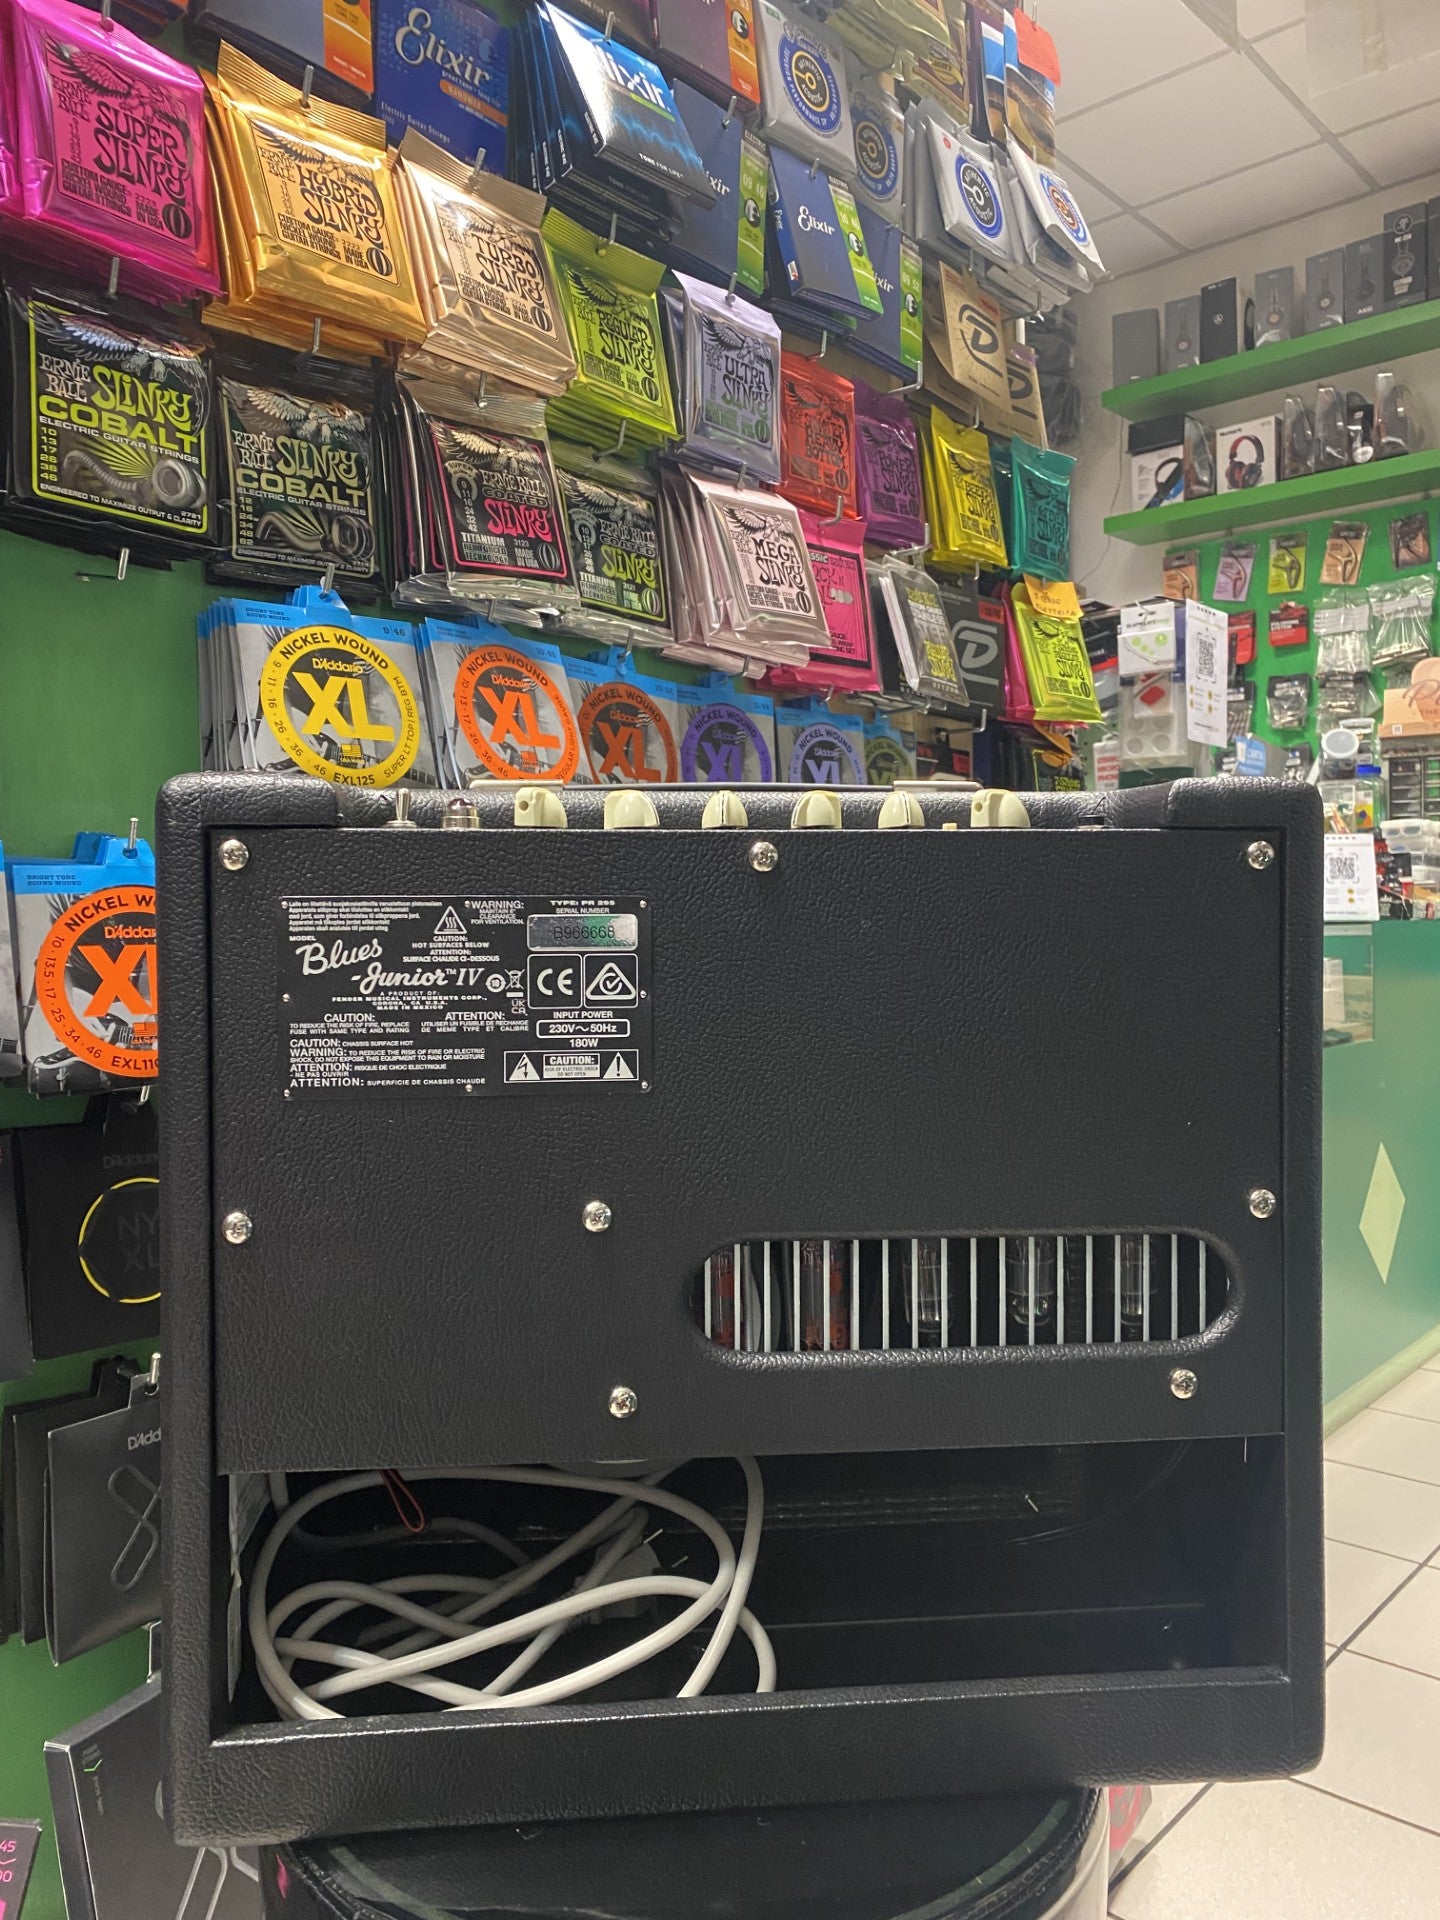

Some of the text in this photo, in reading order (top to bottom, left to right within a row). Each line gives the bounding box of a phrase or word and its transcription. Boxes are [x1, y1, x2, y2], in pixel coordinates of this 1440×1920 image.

[395, 7, 491, 87] Elixir
[381, 101, 450, 143] Electric Guitar Strings
[96, 101, 187, 169] SUPER
[744, 130, 767, 151] ELECTRIC
[278, 213, 335, 240] CUSTOM GAUGE
[798, 205, 835, 236] Elixir
[280, 222, 336, 248] NICKEL WOUND
[282, 230, 342, 260] GUITAR STRINGS
[343, 246, 364, 260] MADE
[472, 233, 536, 280] TURBO
[596, 308, 653, 350] REGULAR
[724, 354, 768, 393] ULTRA
[46, 373, 88, 403] BALL
[39, 395, 198, 455] COBALT
[41, 427, 58, 436] 10
[40, 415, 200, 465] ELECTRIC GUITAR STRINGS
[41, 436, 58, 445] 13
[41, 445, 58, 454] 17
[239, 448, 274, 472] BALL
[880, 450, 914, 474] POWER
[41, 464, 58, 473] 36
[41, 473, 58, 482] 46
[236, 467, 365, 508] COBALT
[40, 483, 88, 500] ENGINEERED
[90, 494, 100, 502] TO
[102, 497, 138, 512] MAXIMIZE
[138, 505, 166, 520] OUTPUT
[174, 514, 202, 527] CLARITY
[236, 486, 367, 516] ELECTRIC GUITAR STRINGS
[482, 487, 550, 508] COATED
[181, 510, 202, 519] 2721
[464, 506, 474, 515] 24
[466, 515, 476, 524] 32
[468, 524, 478, 532] 42
[461, 532, 506, 547] TITANIUM
[514, 539, 530, 548] 3123
[514, 548, 535, 560] MADE
[752, 536, 800, 566] MEGA
[280, 632, 389, 670] NICKEL WOUND
[274, 660, 282, 668] 9
[312, 658, 364, 674] D'Addario
[469, 652, 548, 687] NICKEL WOUND
[268, 676, 276, 686] 11
[268, 698, 278, 708] 16
[292, 671, 396, 742] XL
[590, 688, 662, 724] NICKEL WOUND
[478, 685, 561, 749] XL
[694, 710, 758, 738] NICKEL WOUND
[274, 720, 288, 734] 26
[469, 732, 480, 744] 26
[799, 728, 852, 754] NICKEL WOUND
[290, 744, 304, 758] 36
[481, 752, 492, 764] 36
[598, 721, 662, 782] XL
[313, 764, 326, 776] 46
[498, 766, 509, 778] 46
[333, 772, 376, 787] EXL125
[471, 900, 525, 909] WARNING:
[65, 893, 129, 932] NICKEL
[553, 926, 616, 939] B966668
[52, 936, 65, 948] 10
[295, 938, 383, 976] Blues
[456, 968, 486, 986] IV
[44, 988, 56, 1000] 17
[512, 998, 526, 1006] UK
[50, 1008, 64, 1023] 25
[324, 1013, 376, 1022] CAUTION:
[445, 1012, 506, 1021] ATTENTION:
[552, 1010, 614, 1019] INPUT POWER
[65, 1028, 80, 1043] 34
[290, 1038, 341, 1048] CAUTION:
[570, 1038, 599, 1048] 180W
[86, 1042, 102, 1059] 46
[549, 1056, 596, 1065] CAUTION:
[290, 1078, 364, 1088] ATTENTION:
[127, 1428, 160, 1451] D'Add
[0, 1840, 16, 1852] 45
